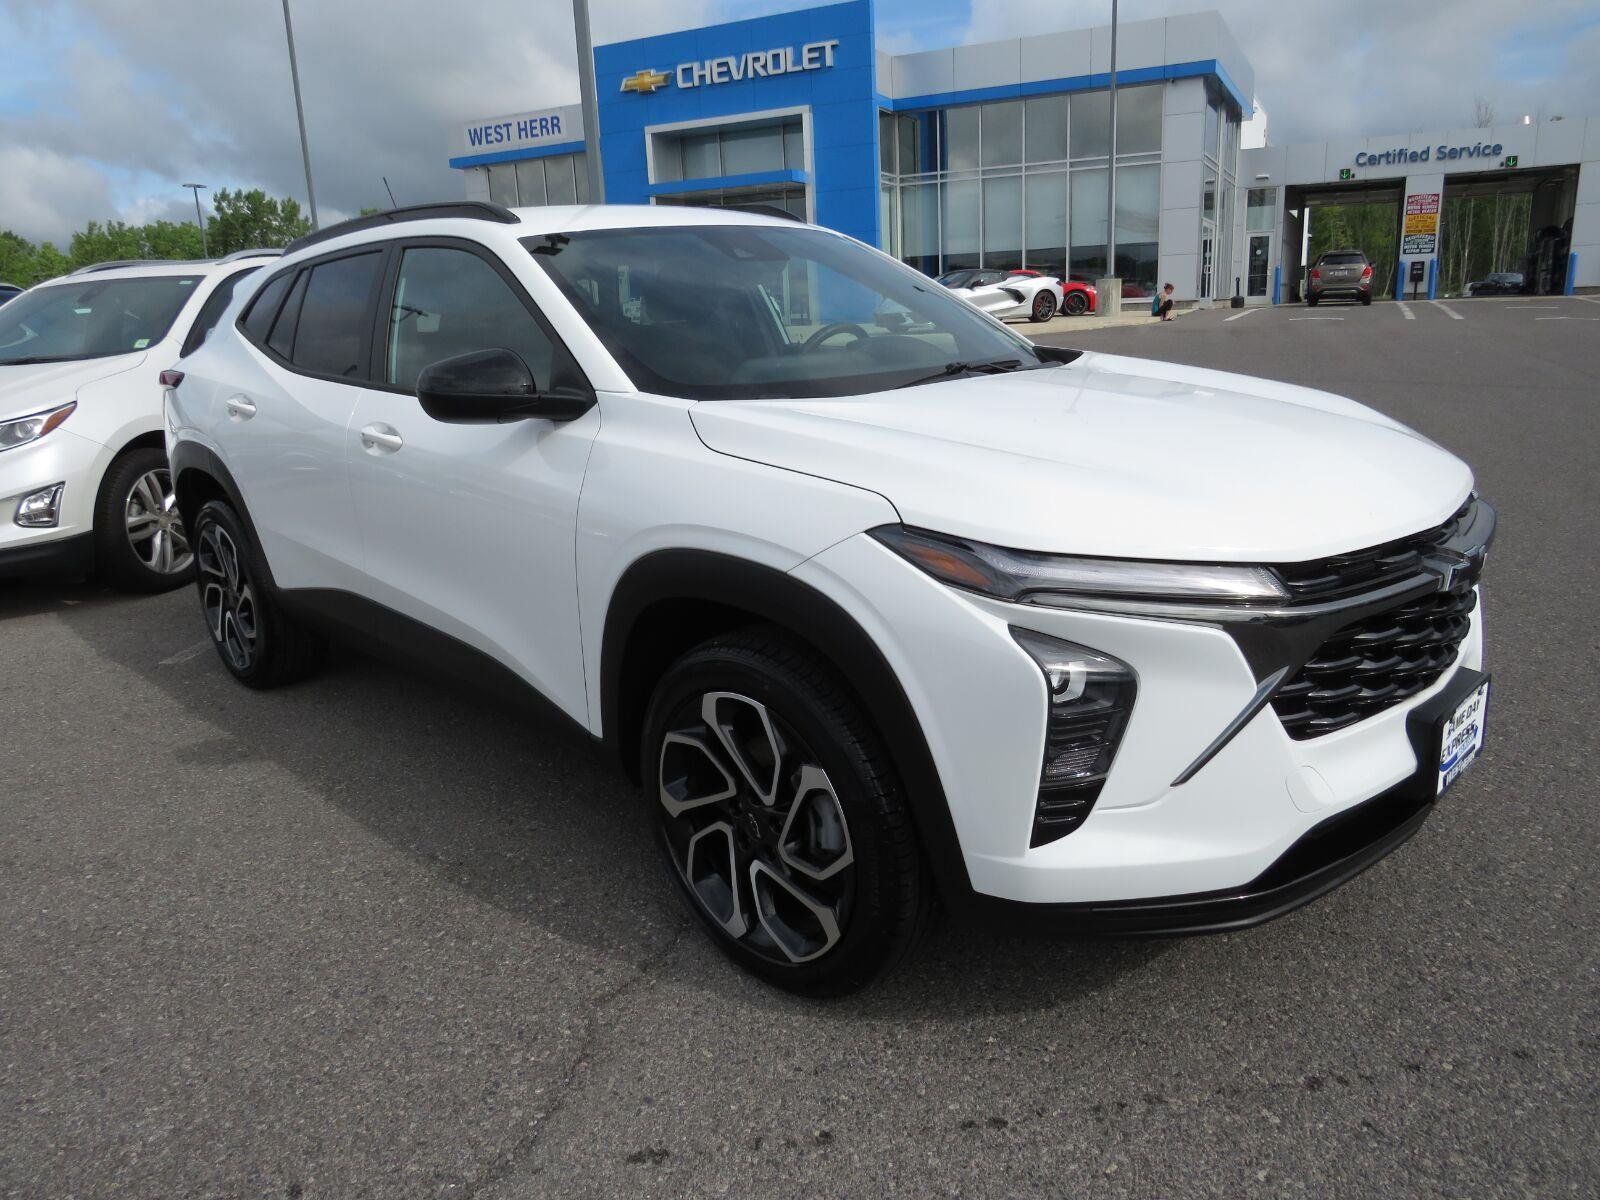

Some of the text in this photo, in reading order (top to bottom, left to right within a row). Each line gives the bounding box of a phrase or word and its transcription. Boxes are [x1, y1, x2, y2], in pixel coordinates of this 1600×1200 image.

[676, 39, 840, 89] CHEVROLET
[467, 115, 562, 147] WEST HERR
[1355, 142, 1503, 167] Certified Service
